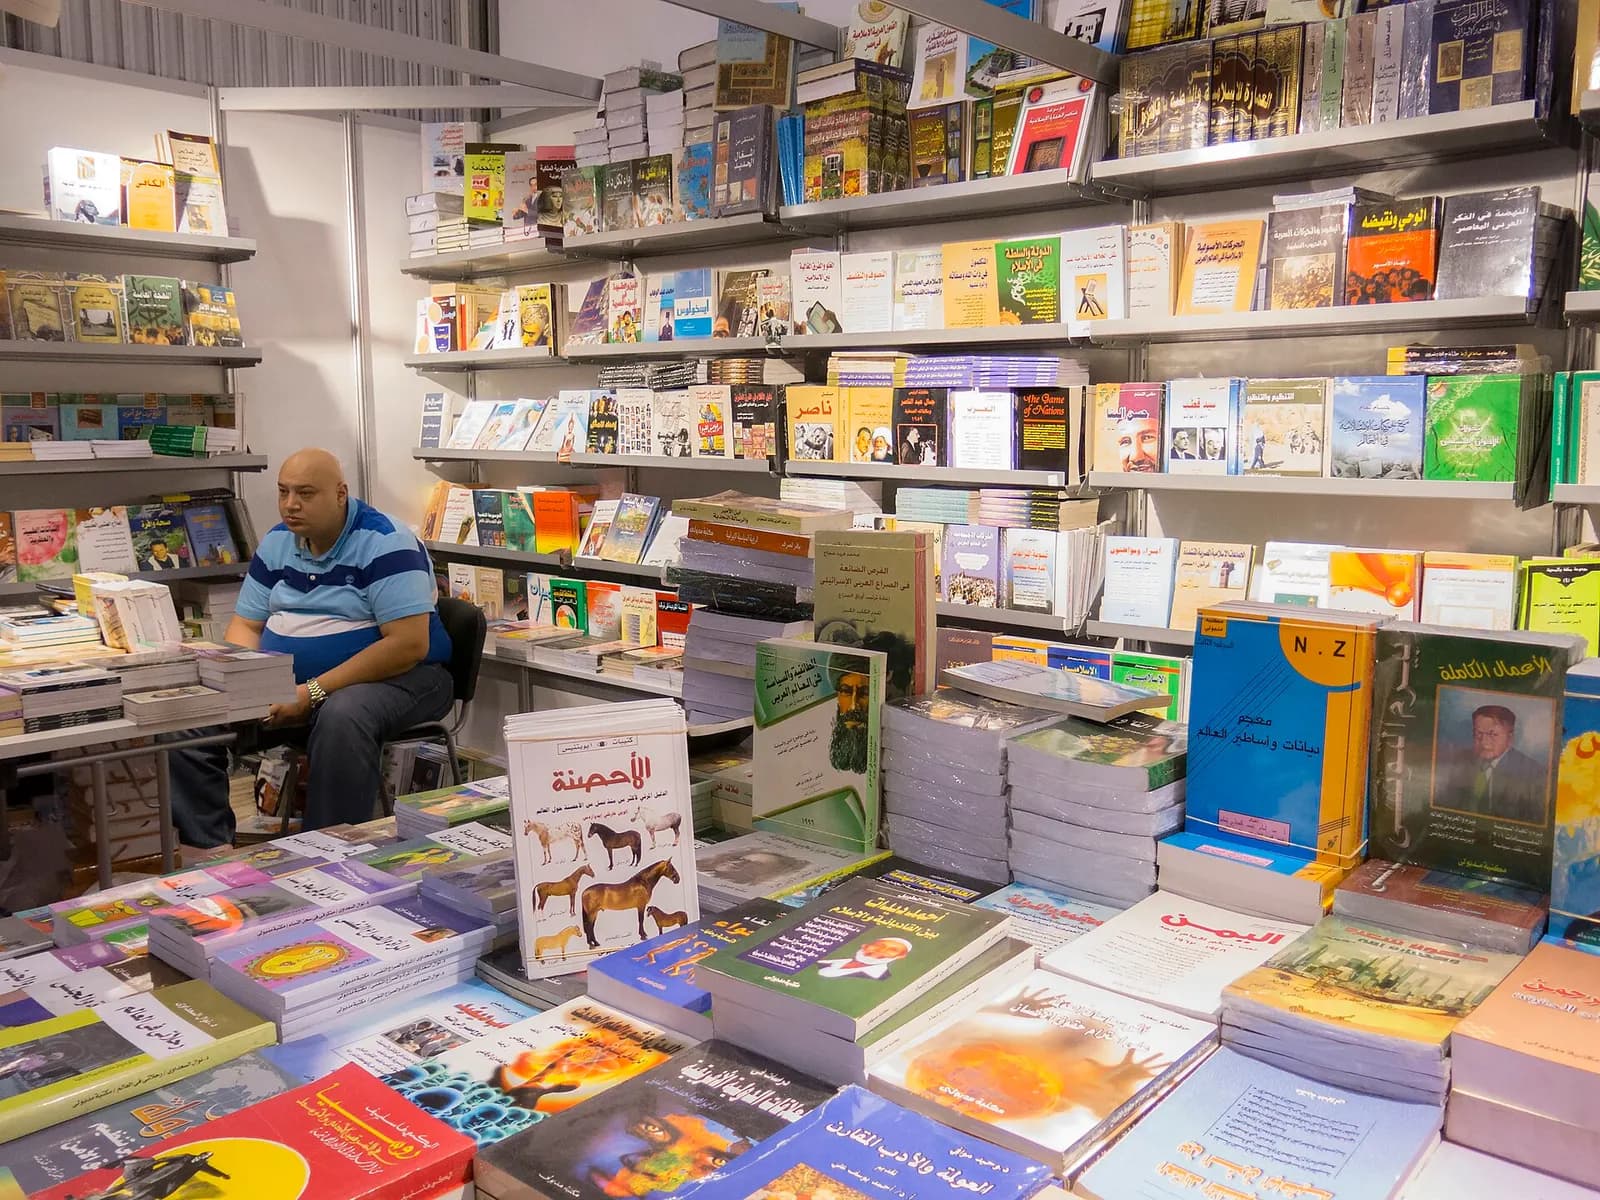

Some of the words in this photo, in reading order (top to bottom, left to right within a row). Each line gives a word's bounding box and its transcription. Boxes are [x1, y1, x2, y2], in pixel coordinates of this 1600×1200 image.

[1452, 212, 1475, 224] الفكر
[1495, 207, 1529, 217] النهضة
[1362, 211, 1399, 229] ونقيضه
[1456, 222, 1489, 234] المعاصر
[1030, 245, 1052, 256] الدولة
[1197, 242, 1222, 252] الأصولية
[1222, 240, 1245, 249] الحركات
[1005, 247, 1030, 259] والسلطة
[1023, 393, 1042, 405] The
[1043, 393, 1064, 405] Game
[1271, 392, 1294, 402] التنظيم
[794, 400, 832, 419] ناصر
[1024, 406, 1031, 418] of
[1032, 405, 1064, 417] Nations
[1203, 400, 1216, 411] سيد
[1107, 407, 1128, 423] البنا
[1127, 409, 1149, 421] حسن
[840, 565, 866, 573] الضائعة
[867, 567, 889, 575] الفرص
[875, 581, 899, 590] الصراع
[1294, 636, 1307, 653] N
[1333, 640, 1346, 658] Z
[793, 657, 817, 674] الطائفية
[1493, 656, 1552, 679] الأعمال
[765, 668, 794, 690] والسياسة
[1440, 663, 1491, 682] الكاملة
[794, 676, 813, 695] العالم
[1237, 715, 1272, 727] معجم
[1197, 726, 1227, 739] العالم
[1233, 733, 1278, 751] وأساطير
[1282, 740, 1320, 757] ديانات
[552, 751, 652, 793] الأحصنة
[1160, 913, 1286, 945] اليمن
[356, 973, 370, 981] مكتبة
[122, 1006, 154, 1024] العالم
[117, 1081, 133, 1093] العالم
[95, 1089, 113, 1099] مكتبة
[976, 1098, 1006, 1115] مكتبة
[825, 1121, 883, 1152] المقارن
[936, 1165, 996, 1195] العولمة
